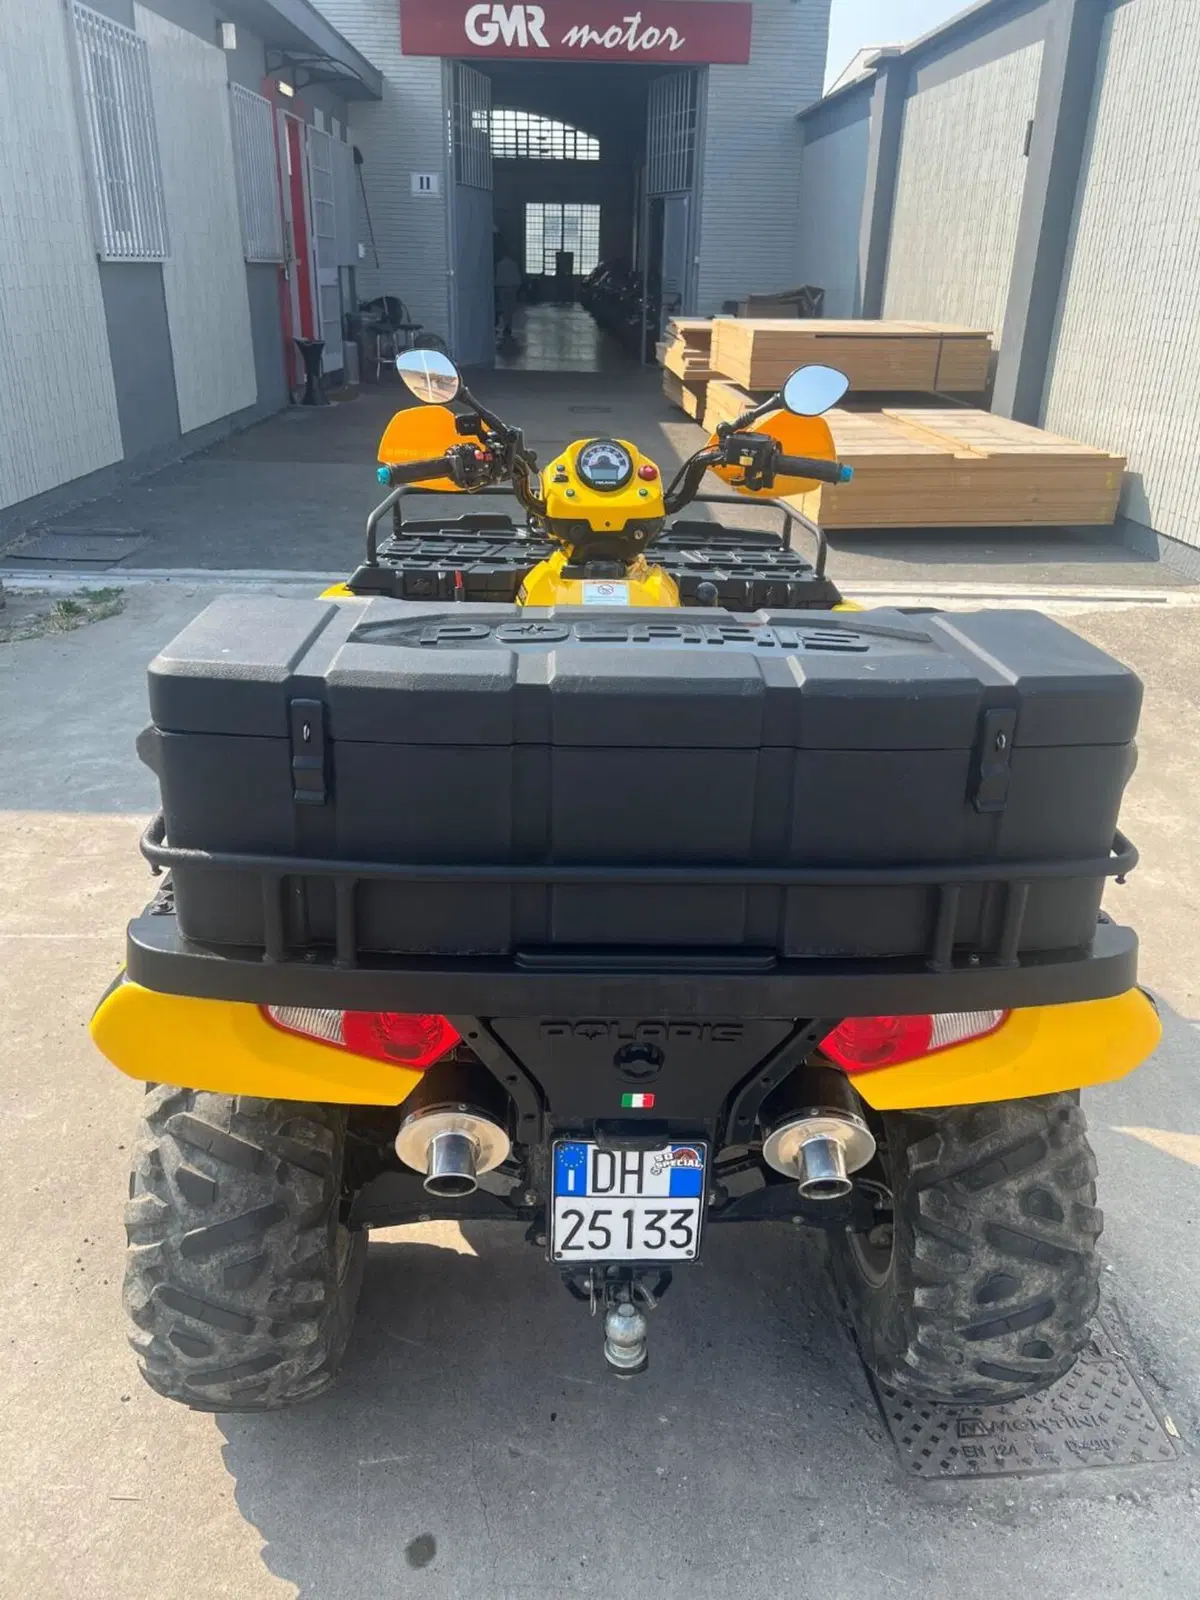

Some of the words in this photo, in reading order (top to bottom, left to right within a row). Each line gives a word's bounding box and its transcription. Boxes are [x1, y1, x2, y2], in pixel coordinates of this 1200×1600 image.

[464, 4, 550, 48] GMR
[561, 12, 685, 51] motor
[419, 622, 870, 652] POLARIS
[539, 1020, 744, 1042] POLARIS
[592, 1150, 645, 1194] DH
[561, 1209, 694, 1250] 25133
